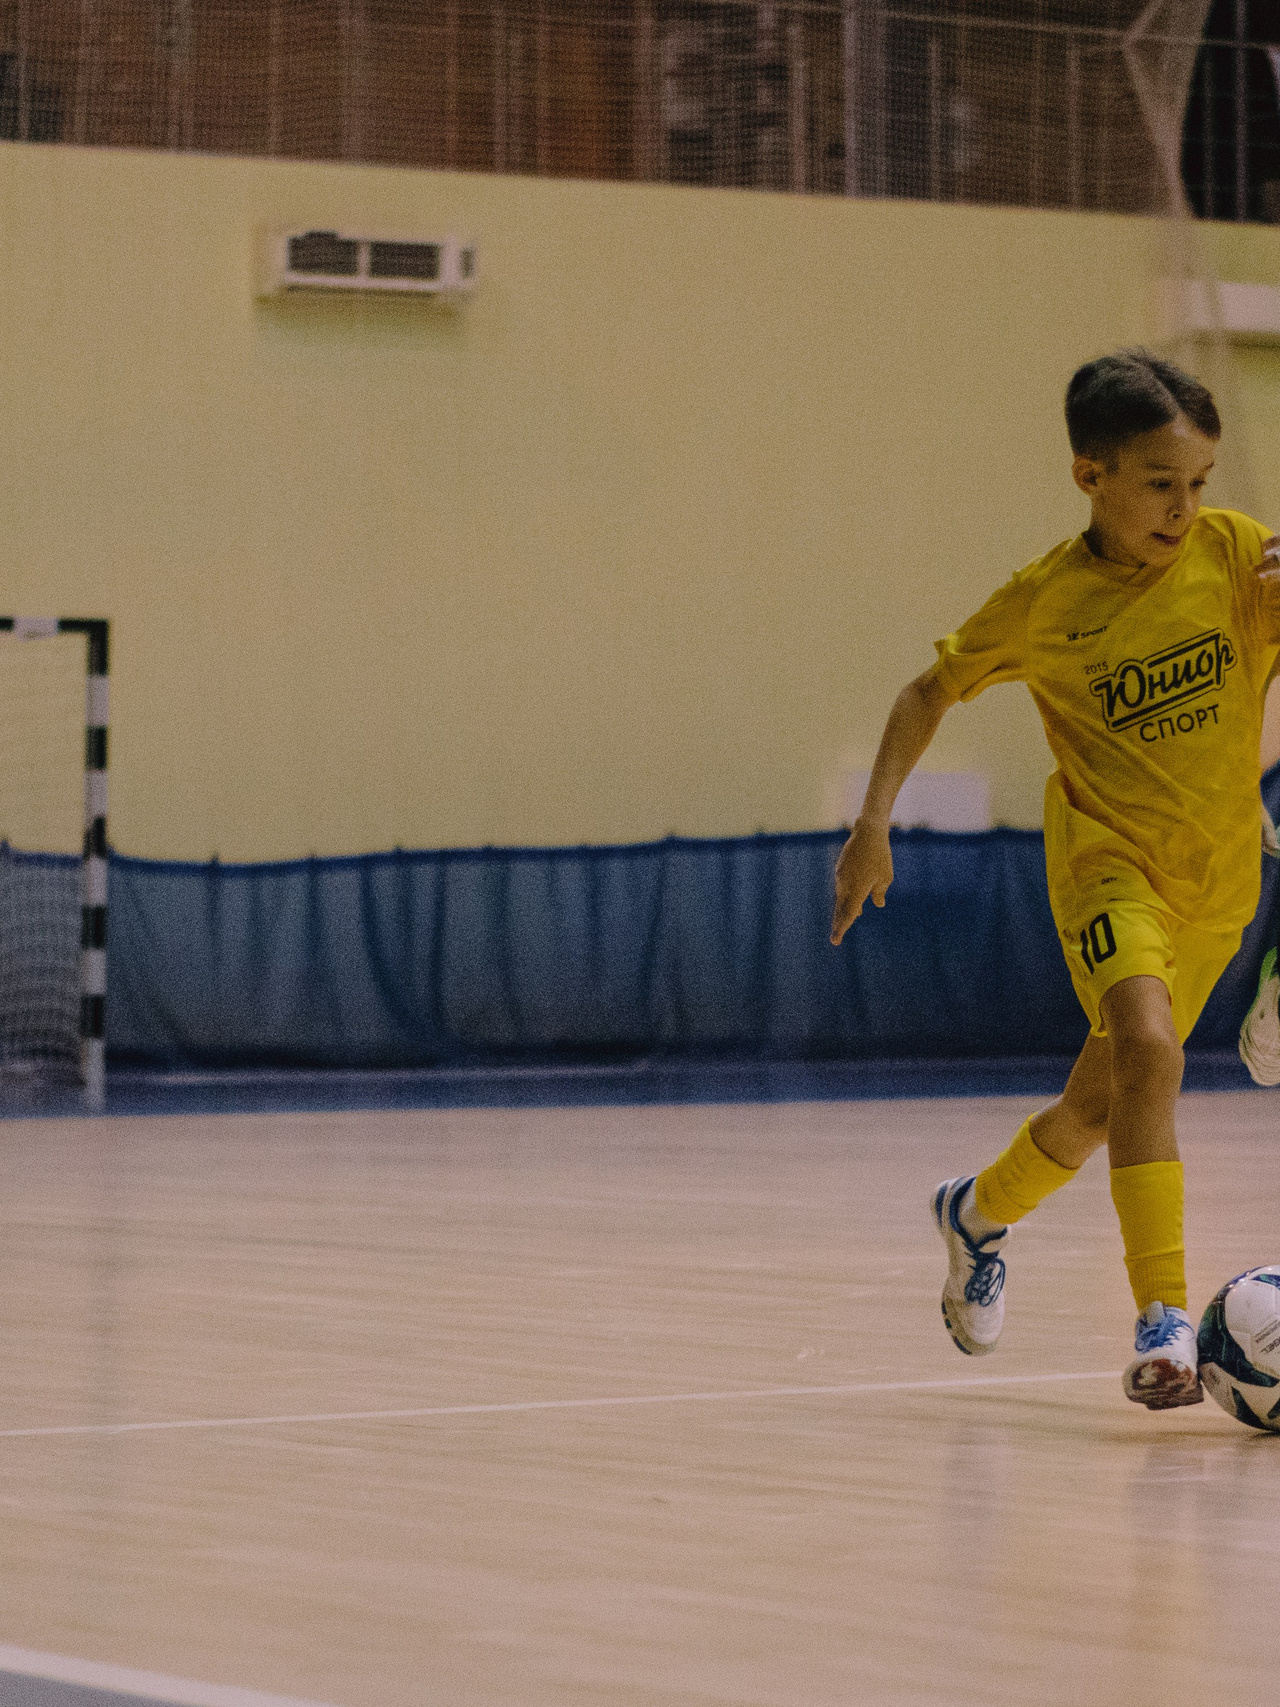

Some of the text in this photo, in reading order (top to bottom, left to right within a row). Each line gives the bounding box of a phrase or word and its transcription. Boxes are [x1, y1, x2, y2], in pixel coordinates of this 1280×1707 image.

[1084, 661, 1109, 676] 2015
[1094, 633, 1235, 718] Юниор
[1139, 704, 1219, 742] СПОРТ
[1080, 912, 1117, 975] 10
